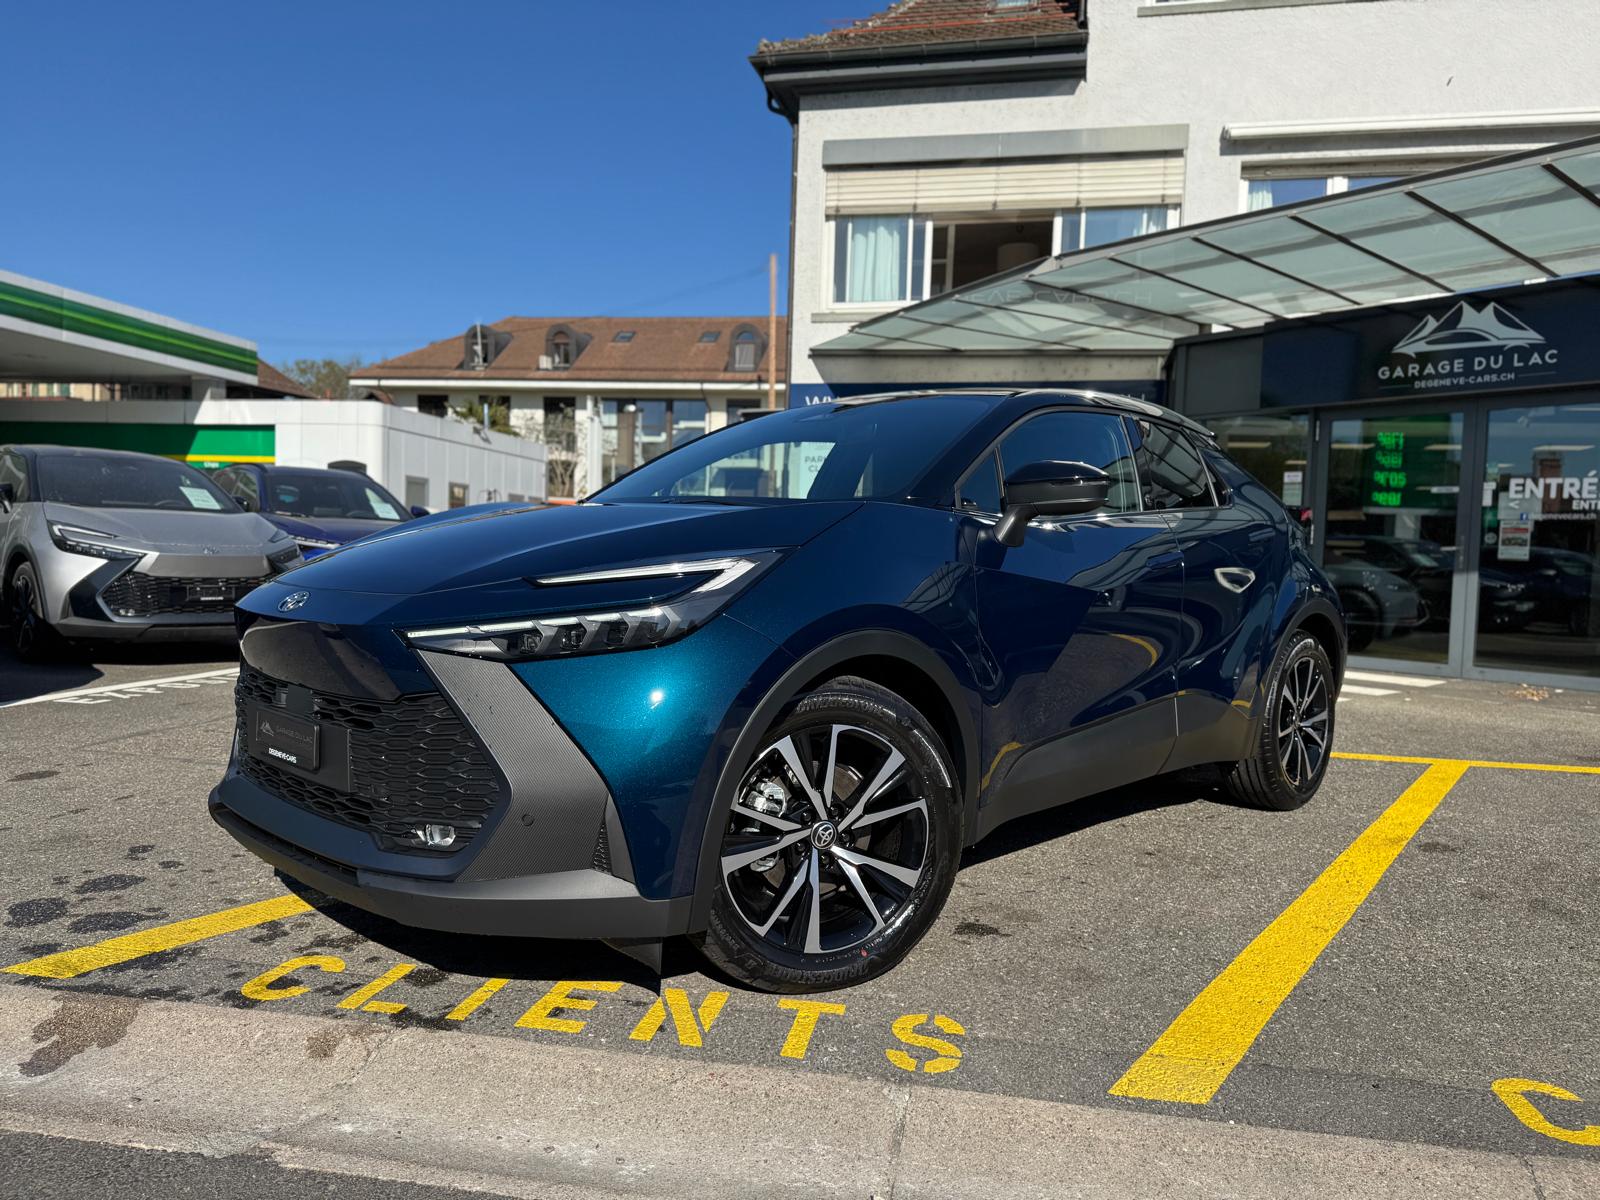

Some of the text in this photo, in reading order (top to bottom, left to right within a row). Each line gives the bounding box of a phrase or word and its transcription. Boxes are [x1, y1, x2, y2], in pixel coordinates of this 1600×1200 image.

[1377, 348, 1559, 380] GARAGE DU LAC
[1413, 372, 1516, 389] DEGENEVE-CARS.CH
[1508, 470, 1600, 499] ENTRÉ
[241, 954, 966, 1074] CLIENTS
[1490, 1077, 1600, 1147] C
